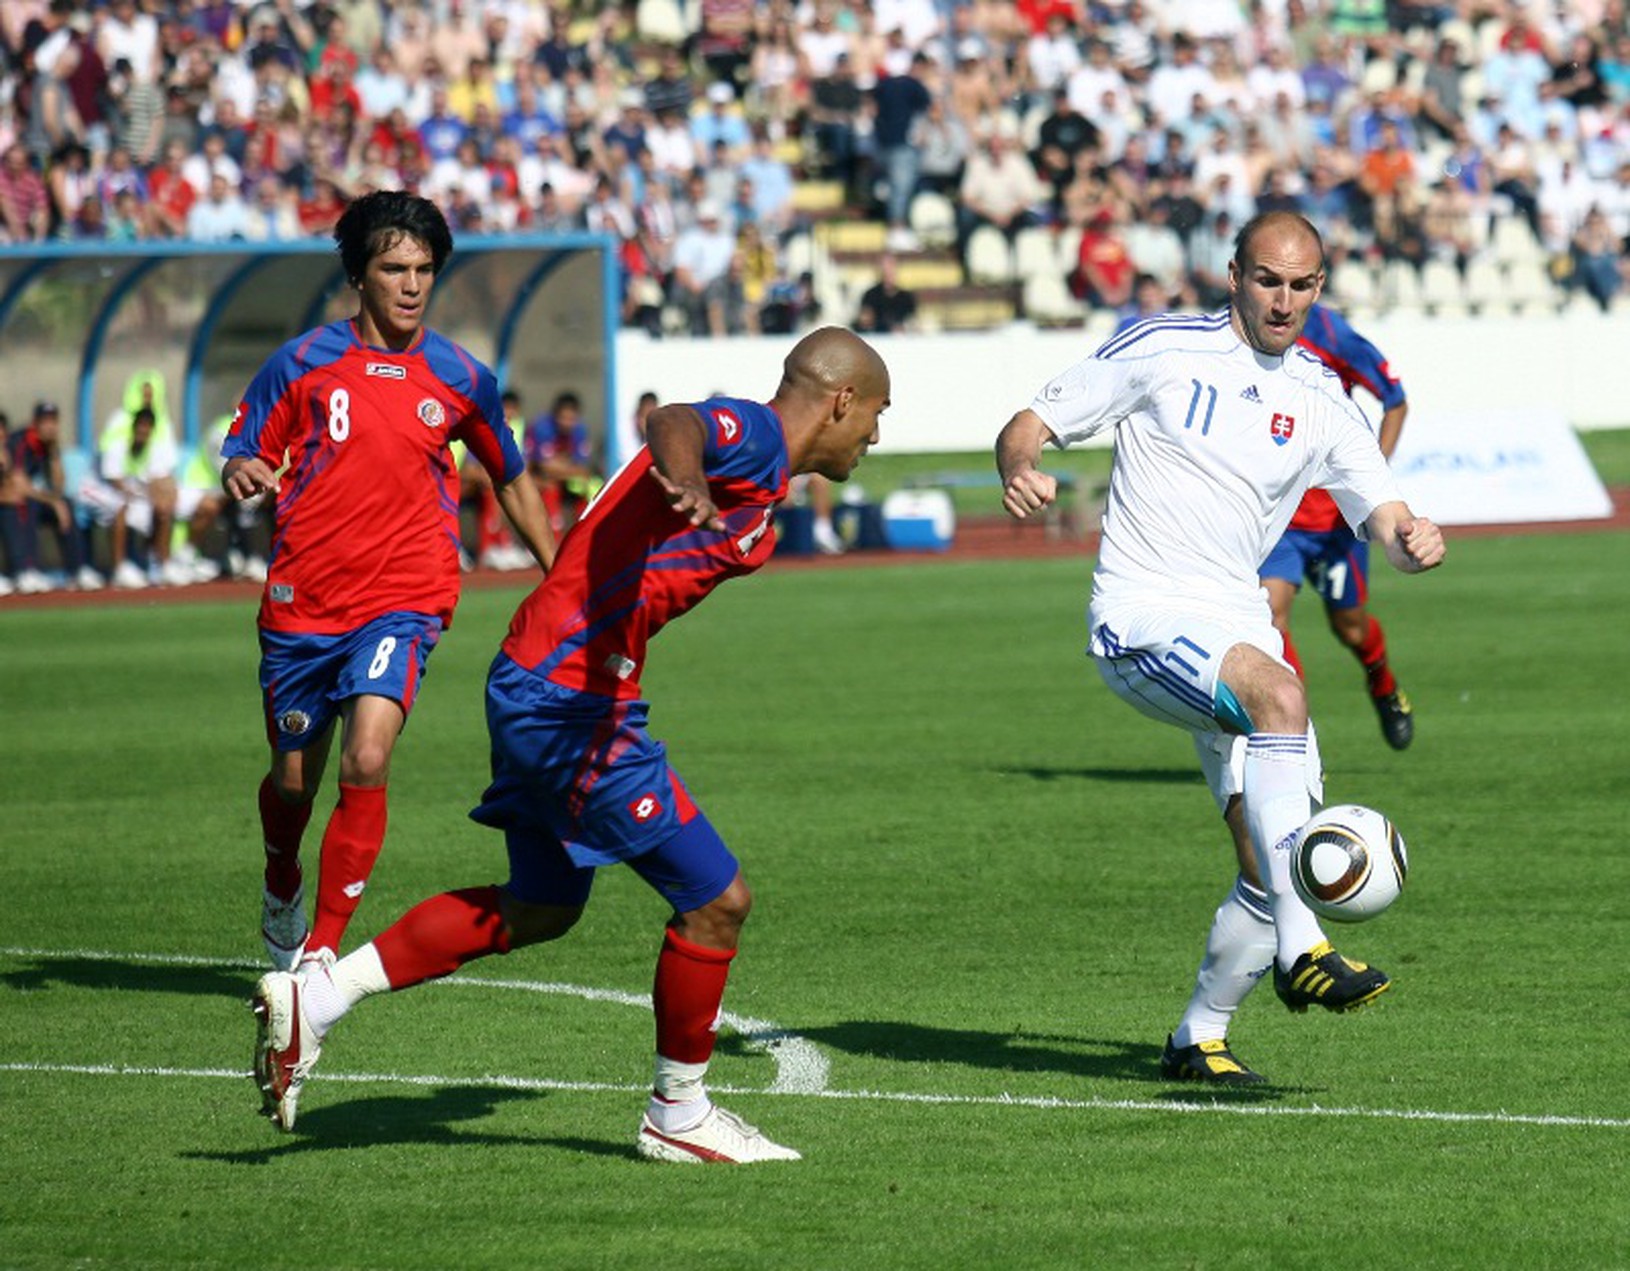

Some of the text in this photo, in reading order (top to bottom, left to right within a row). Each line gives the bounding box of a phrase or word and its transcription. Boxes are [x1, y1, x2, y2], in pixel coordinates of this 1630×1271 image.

[329, 388, 350, 443] 8
[1184, 379, 1218, 436] 11
[368, 636, 397, 680] 8
[1165, 635, 1211, 677] 11
